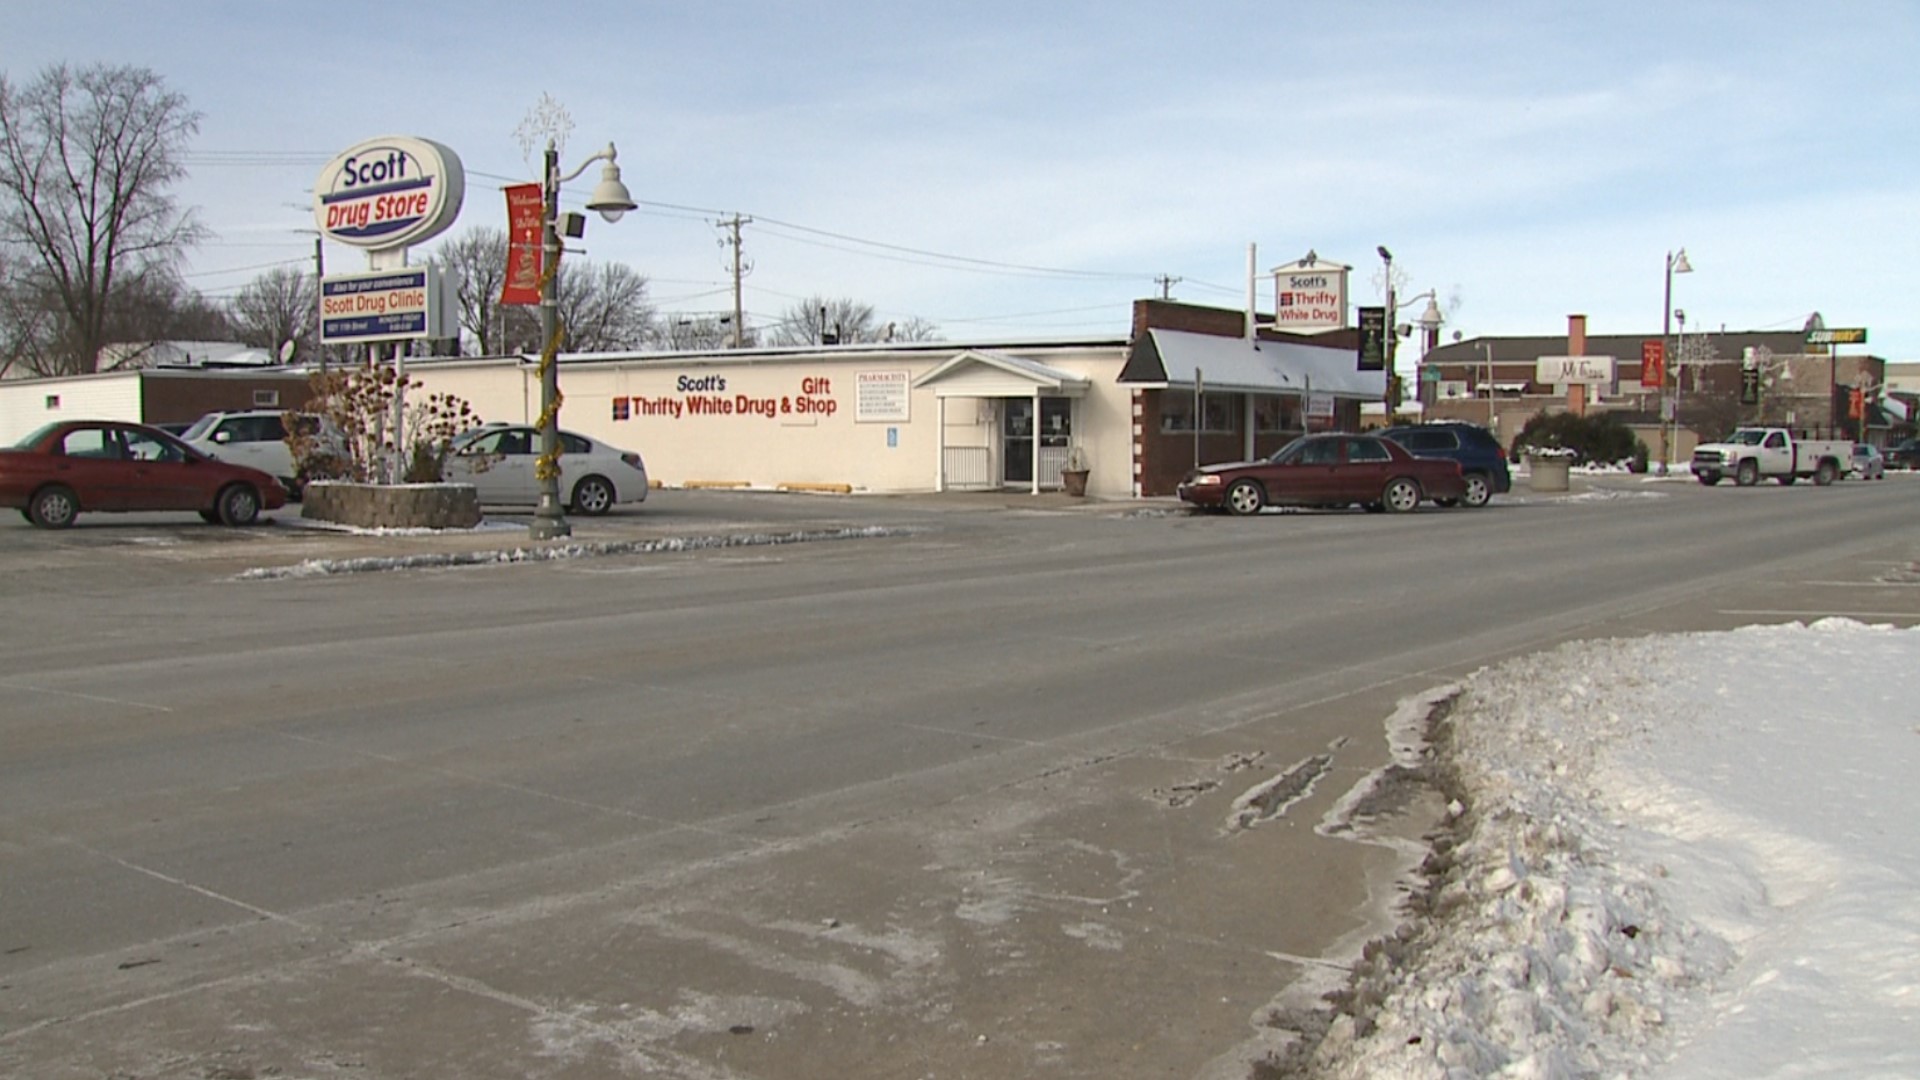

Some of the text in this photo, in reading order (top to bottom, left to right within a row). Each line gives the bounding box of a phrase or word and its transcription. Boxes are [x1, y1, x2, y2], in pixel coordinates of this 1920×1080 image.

[344, 151, 406, 187] Scott
[326, 191, 428, 228] Drug Store
[1290, 276, 1328, 288] Scott's
[324, 290, 425, 314] Scott Drug Clinic
[1296, 291, 1337, 306] Thrifty
[1280, 308, 1338, 322] White Drug
[1806, 330, 1863, 343] SUBWAY
[676, 375, 726, 392] Scott's
[801, 377, 831, 395] Gift
[632, 396, 683, 419] Thrifty
[686, 396, 733, 415] White
[735, 395, 776, 419] Drug
[780, 396, 792, 414] &
[795, 396, 837, 417] Shop
